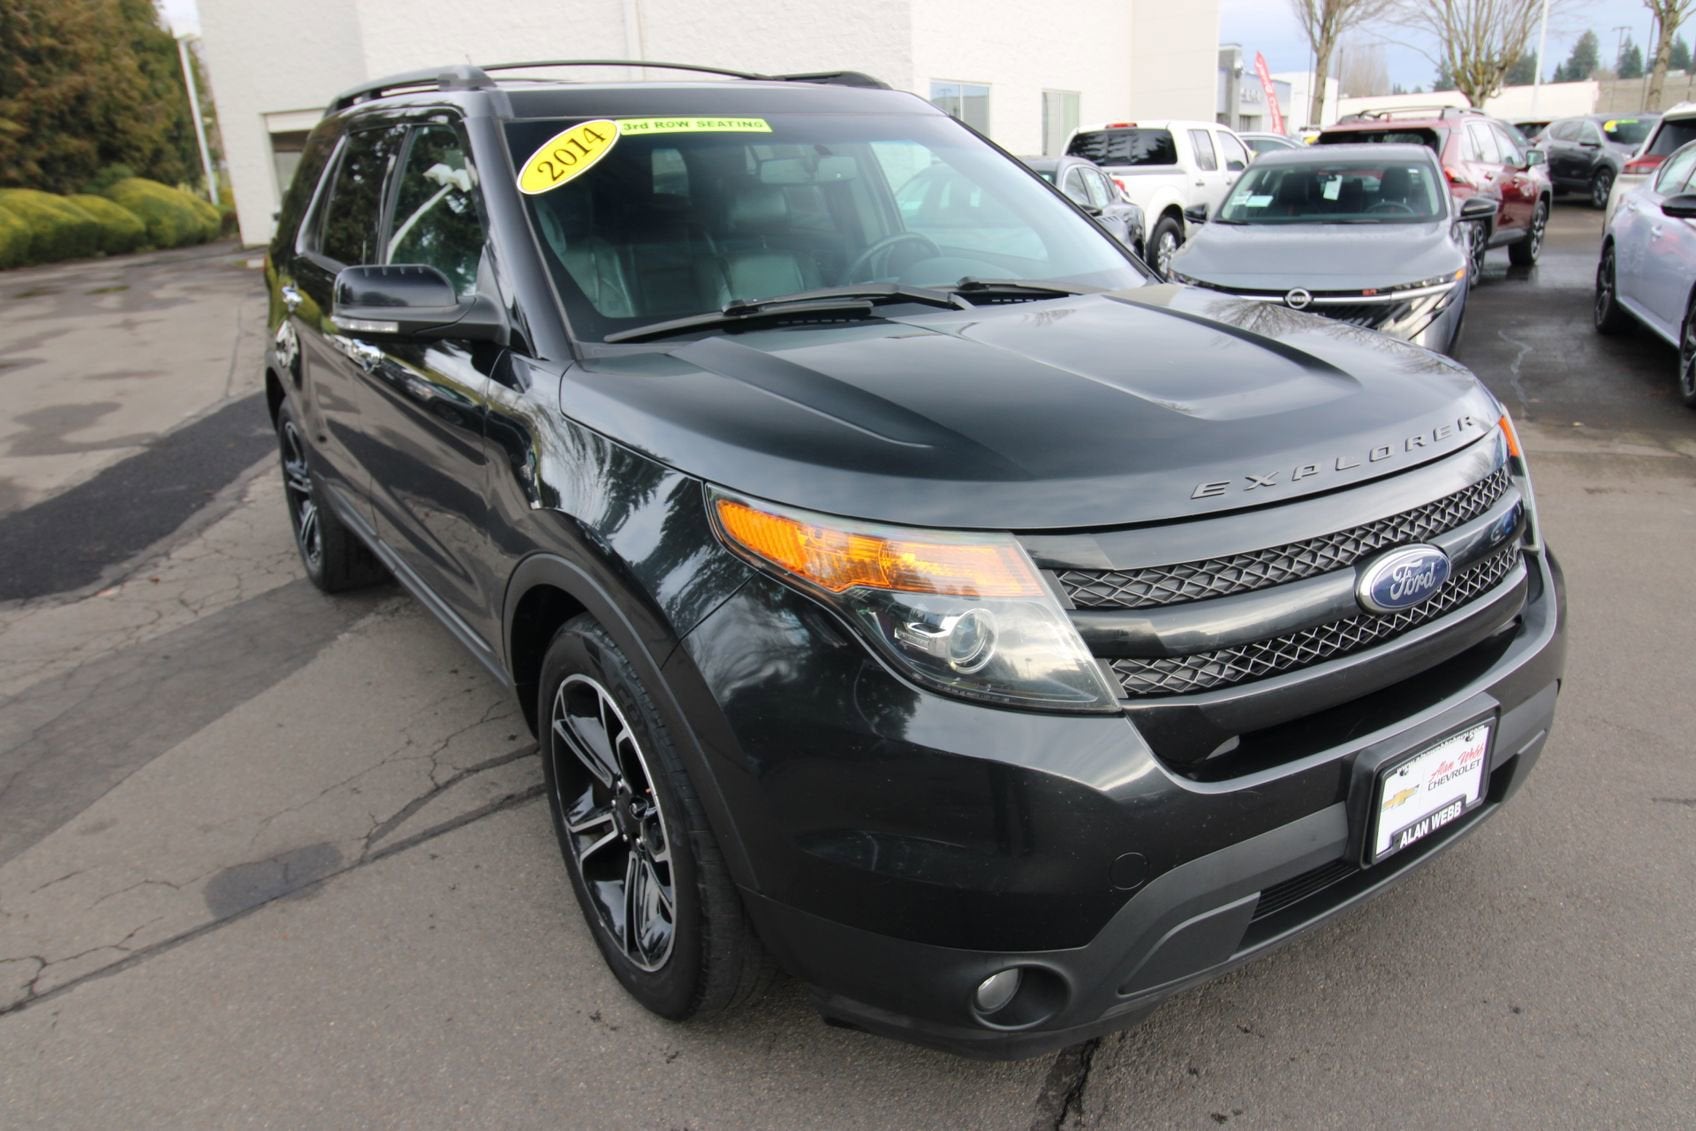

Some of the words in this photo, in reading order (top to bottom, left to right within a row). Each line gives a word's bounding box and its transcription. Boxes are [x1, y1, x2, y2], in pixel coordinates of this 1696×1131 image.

[623, 121, 649, 131] 3rd
[654, 120, 690, 129] ROW
[696, 120, 764, 129] SEATING
[537, 126, 606, 181] 2014
[1191, 415, 1476, 499] EXPLORER
[1390, 559, 1436, 600] Ford
[1427, 758, 1482, 791] CHEVROLET
[1400, 818, 1430, 848] ALAN
[1431, 801, 1462, 831] WEBB
